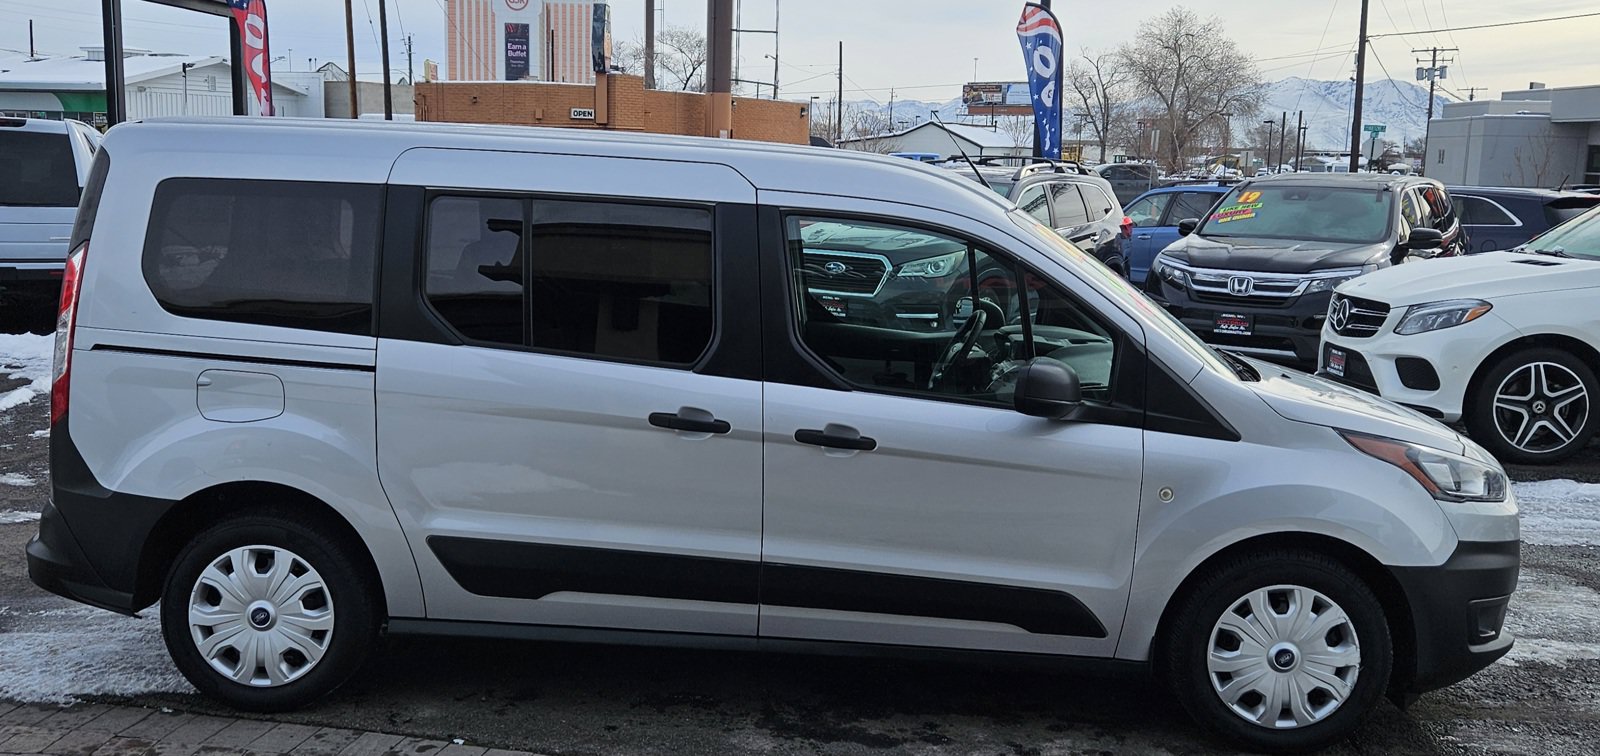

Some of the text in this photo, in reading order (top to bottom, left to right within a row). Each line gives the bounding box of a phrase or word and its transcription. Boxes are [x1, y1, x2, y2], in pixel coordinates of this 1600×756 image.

[507, 50, 527, 58] Buffet
[573, 110, 593, 118] OPEN
[1237, 191, 1263, 203] 19
